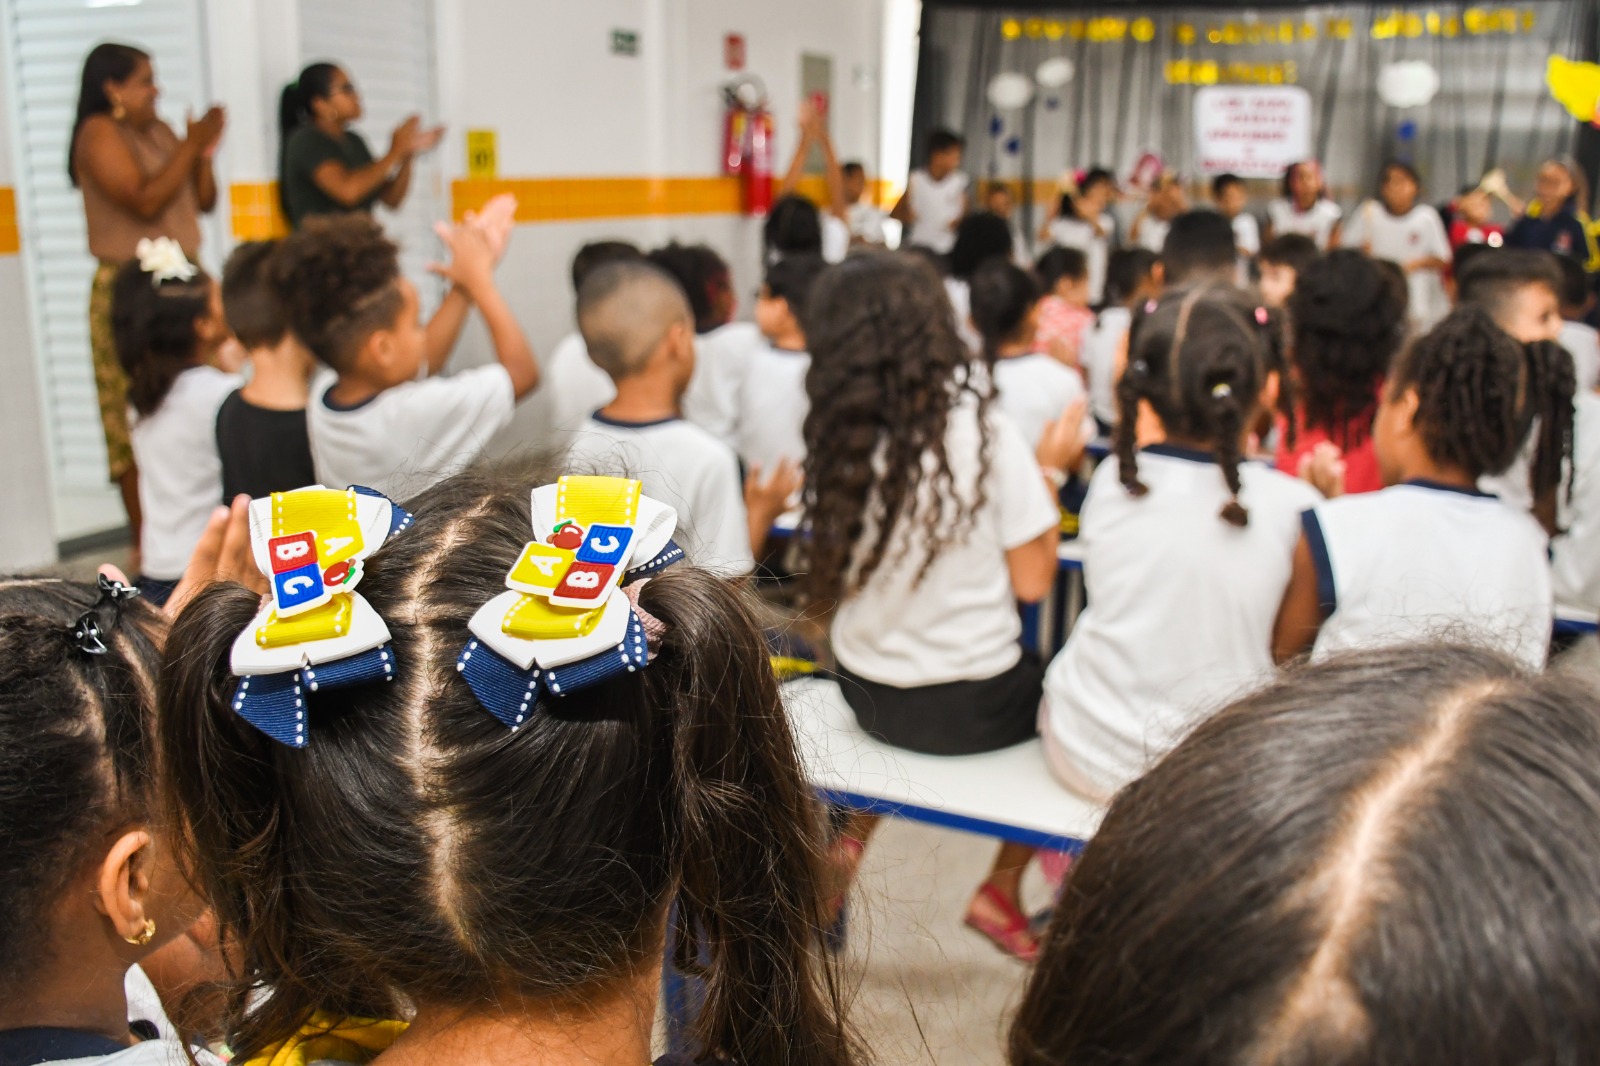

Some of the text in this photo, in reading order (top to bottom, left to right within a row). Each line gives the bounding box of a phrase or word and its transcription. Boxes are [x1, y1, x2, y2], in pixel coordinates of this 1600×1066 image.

[276, 539, 310, 560] B
[324, 536, 354, 557] A
[591, 535, 620, 554] C
[532, 554, 563, 575] A
[283, 575, 314, 595] C
[566, 571, 599, 589] B
